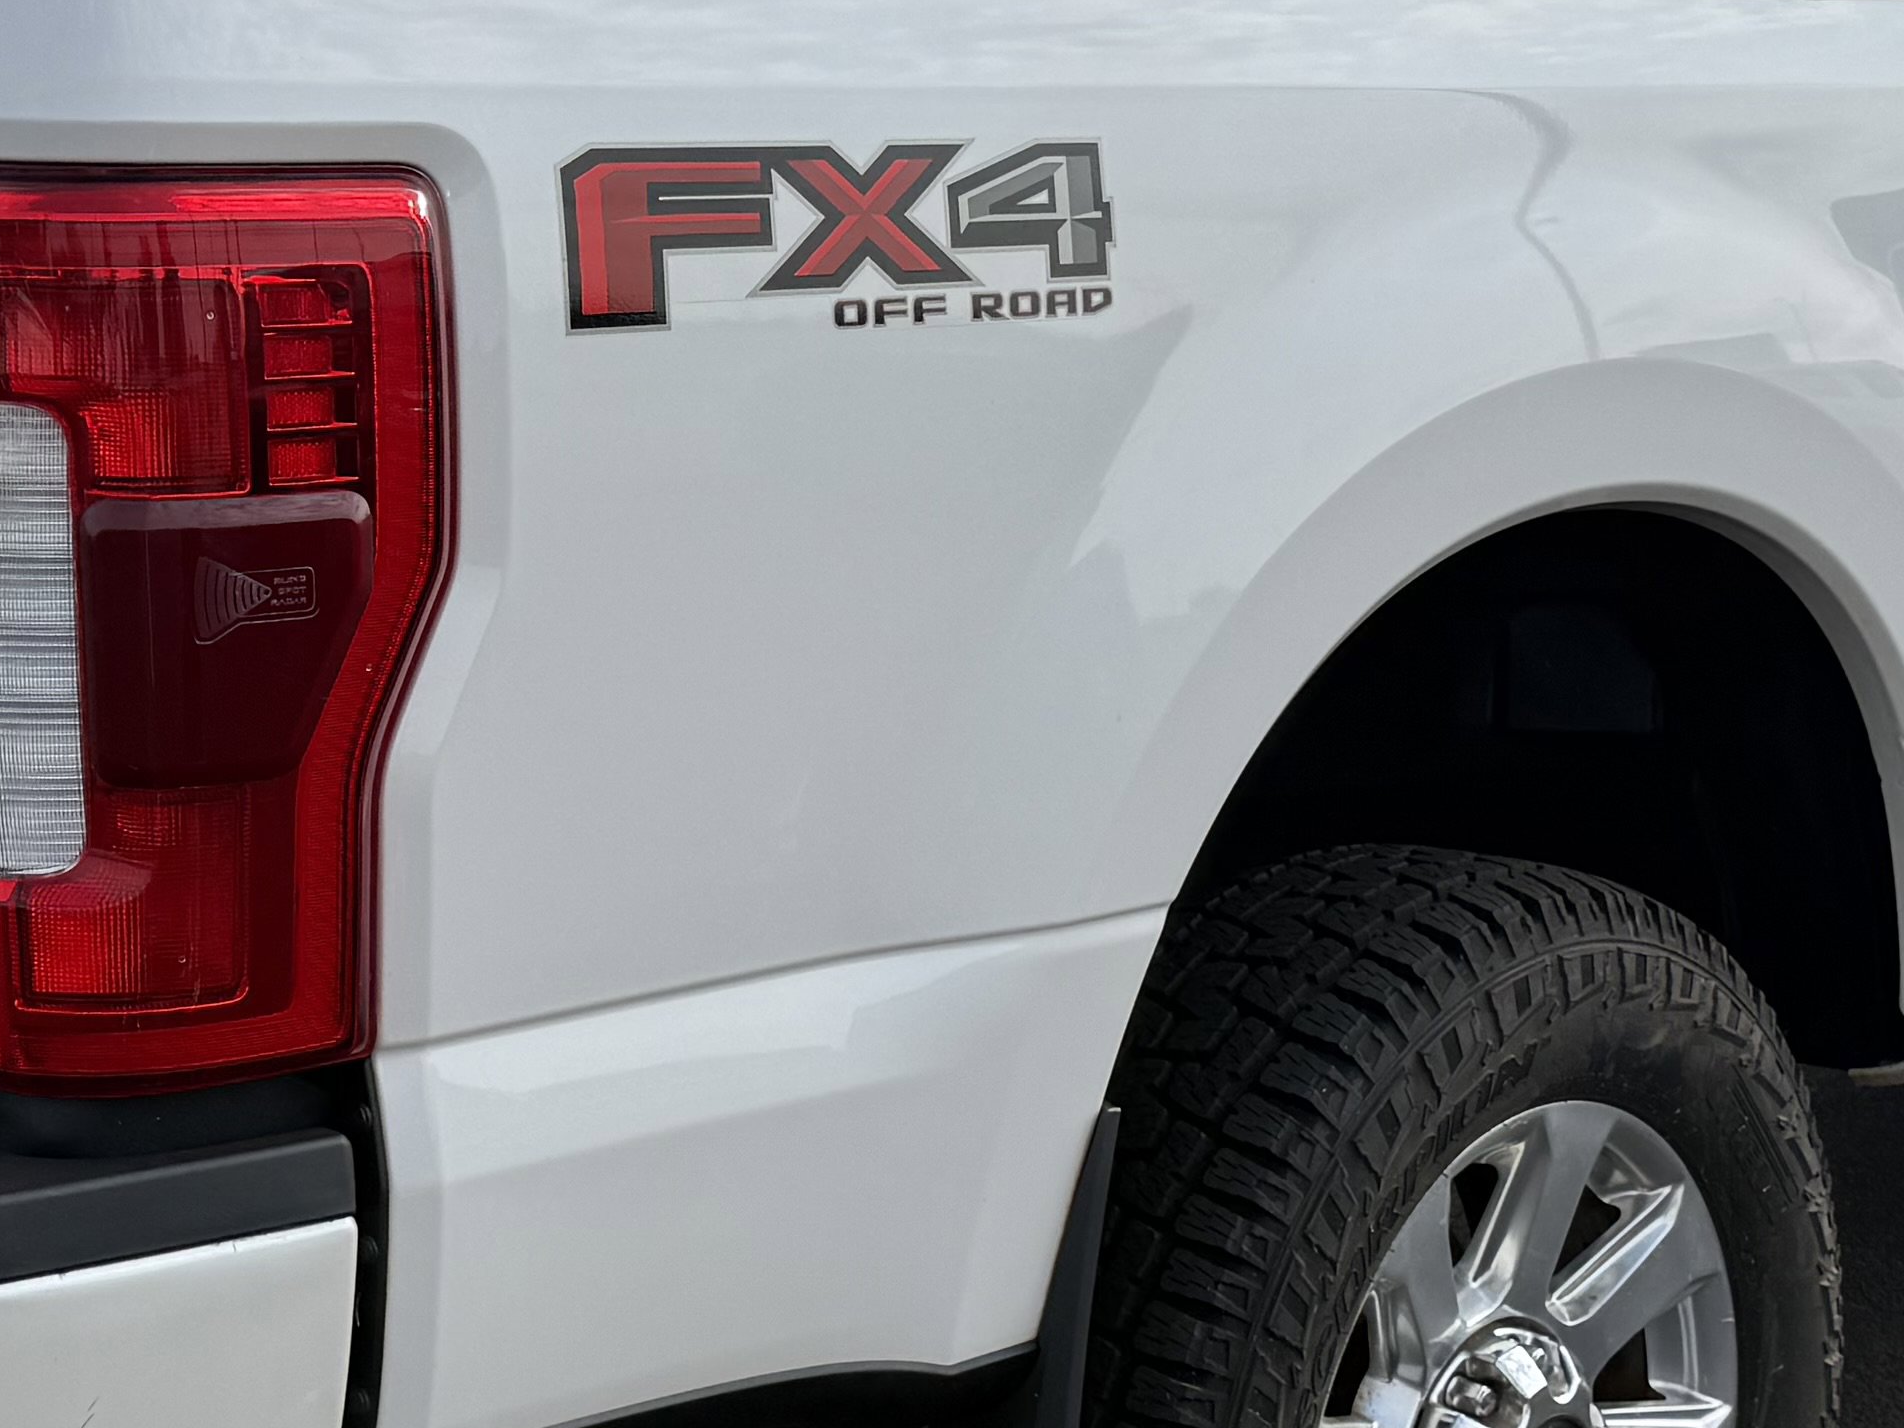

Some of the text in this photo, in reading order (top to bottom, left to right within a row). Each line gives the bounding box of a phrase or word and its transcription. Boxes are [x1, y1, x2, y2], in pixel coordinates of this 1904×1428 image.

[556, 137, 1115, 336] FX4
[833, 285, 1114, 330] OFF ROAD
